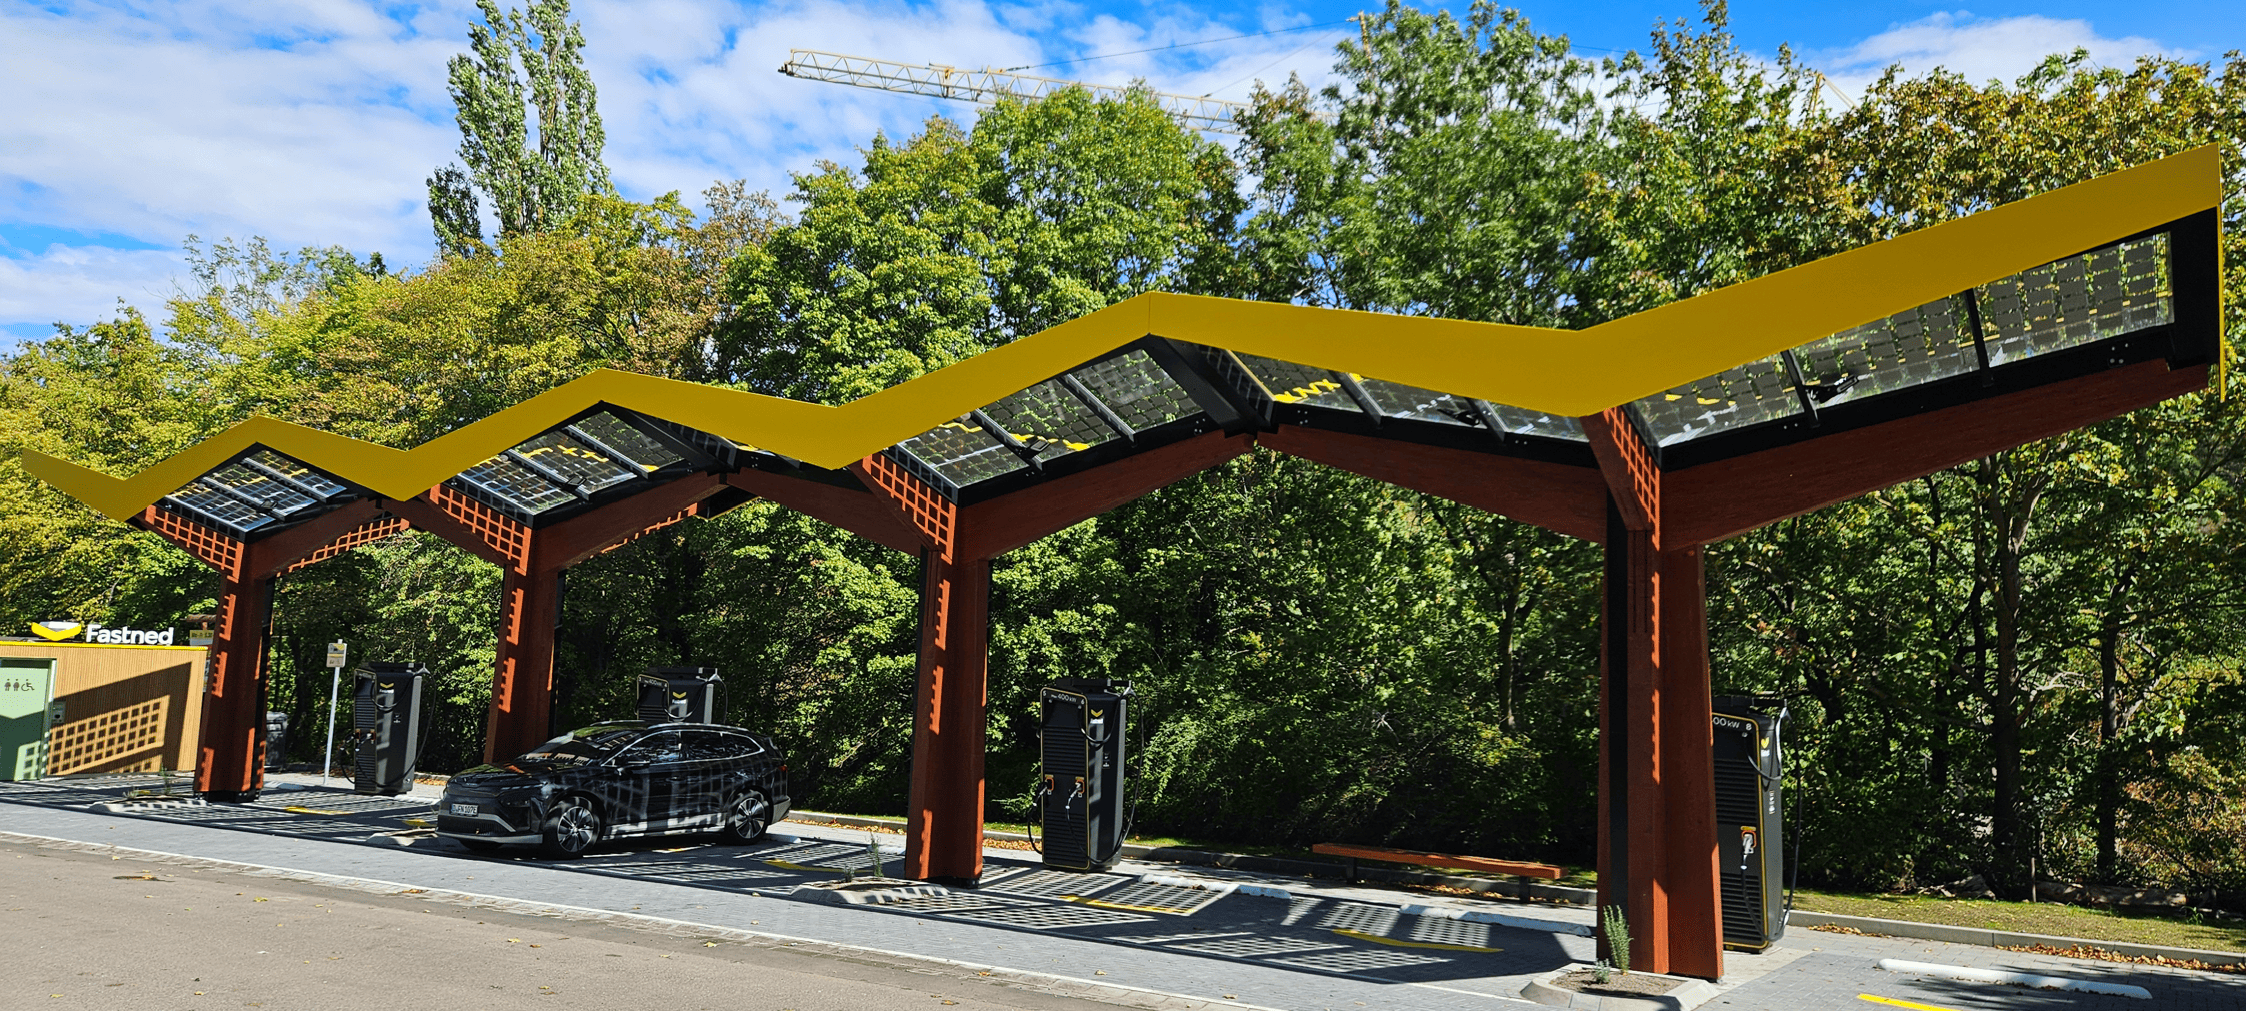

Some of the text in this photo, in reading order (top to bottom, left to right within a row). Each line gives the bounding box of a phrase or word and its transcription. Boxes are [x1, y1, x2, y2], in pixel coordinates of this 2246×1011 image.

[86, 624, 174, 645] Fastned
[1711, 716, 1740, 728] 00 kW
